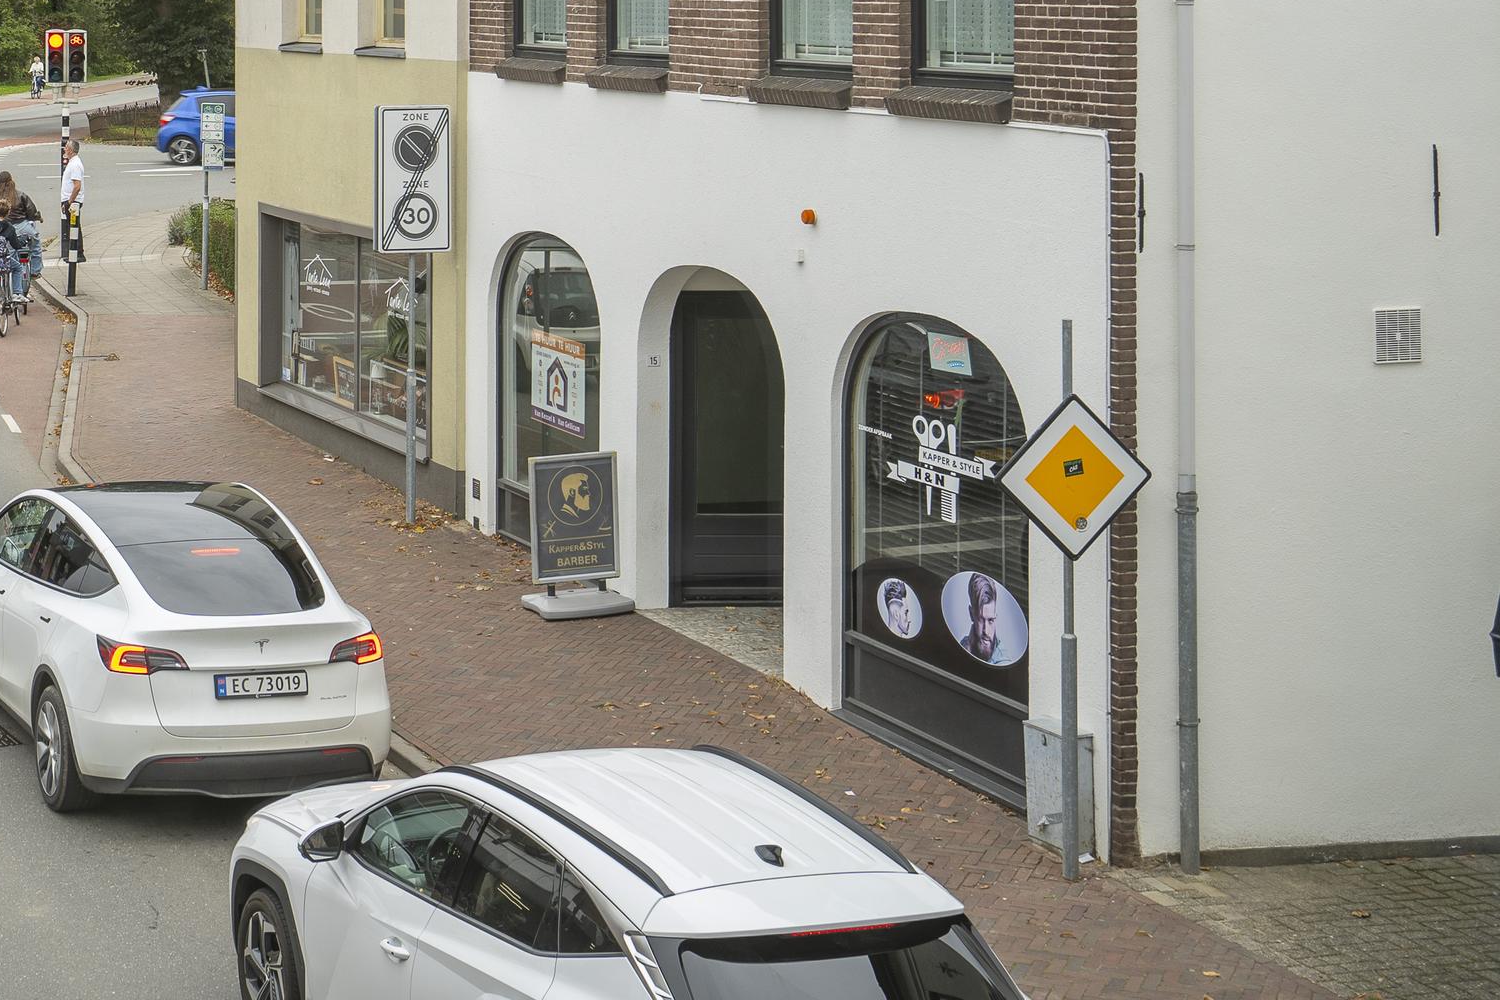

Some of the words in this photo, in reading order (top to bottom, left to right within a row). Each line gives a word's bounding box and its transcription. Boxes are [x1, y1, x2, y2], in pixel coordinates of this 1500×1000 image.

[402, 113, 429, 121] ZONE
[402, 207, 430, 224] 30
[650, 356, 658, 365] 15
[922, 450, 951, 467] KAPPER
[951, 460, 958, 468] &
[959, 461, 981, 475] STYLE
[914, 467, 922, 479] H
[924, 472, 933, 483] &
[935, 473, 945, 487] N
[557, 554, 598, 567] BARBER
[232, 677, 251, 693] EC
[256, 675, 301, 692] 73019
